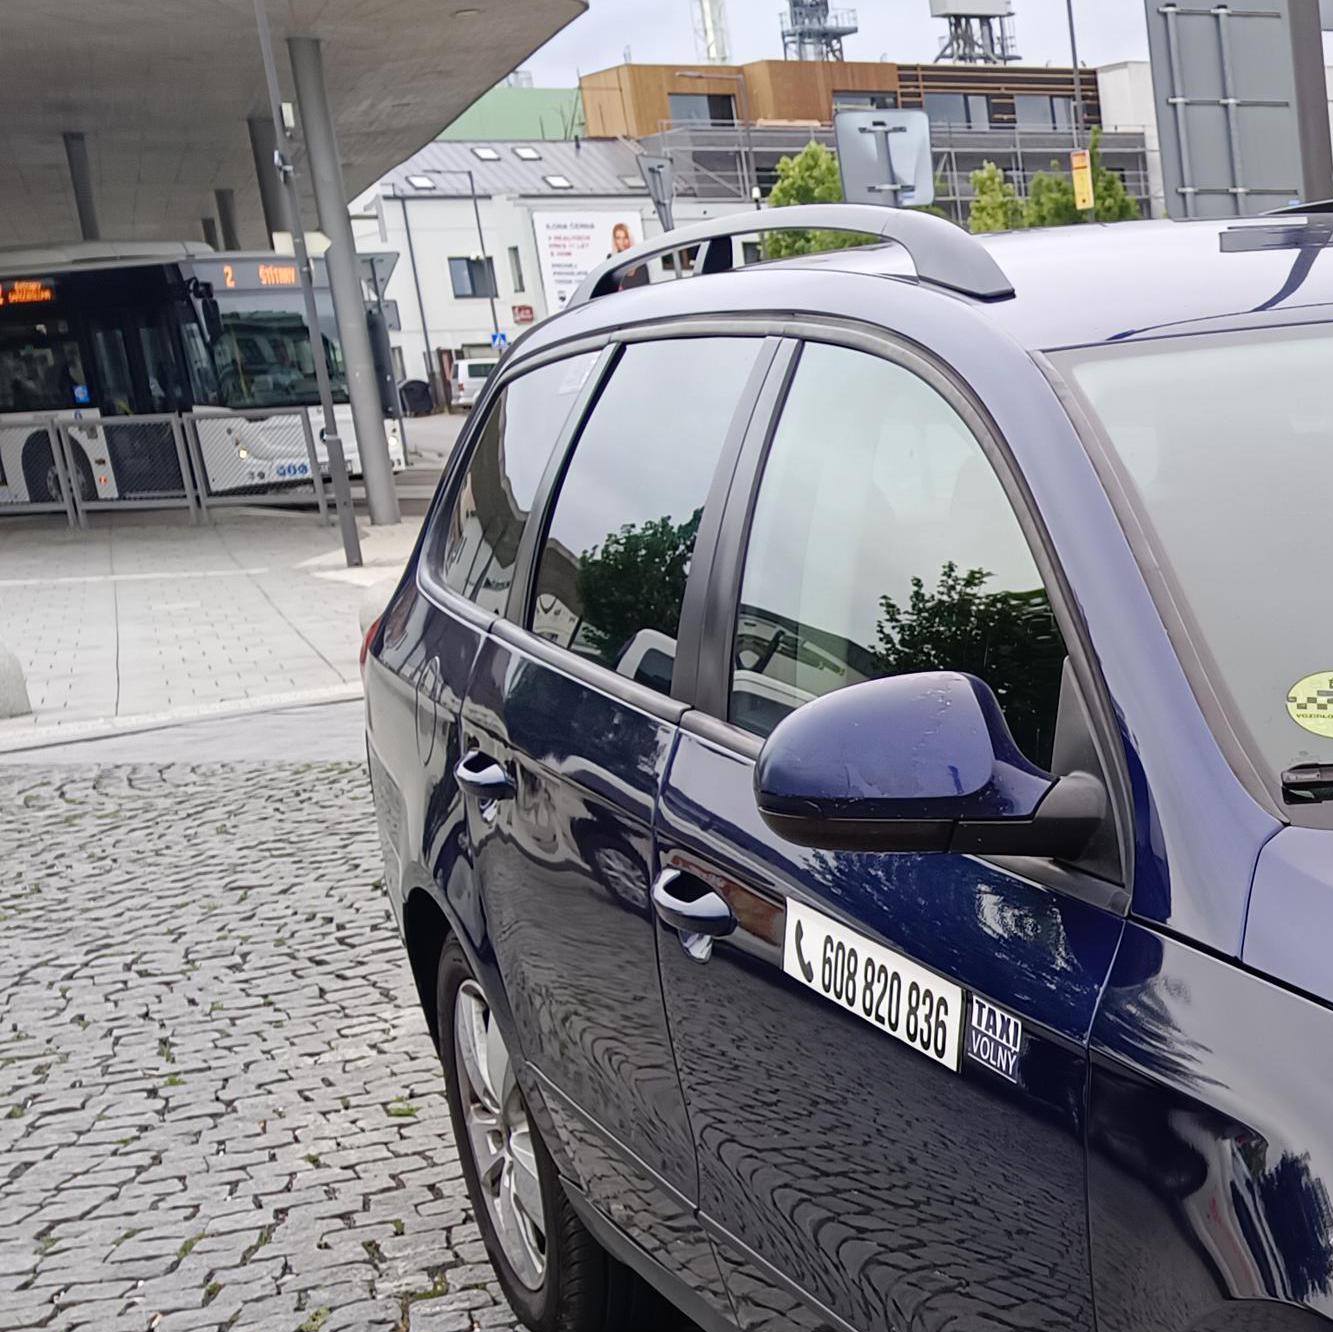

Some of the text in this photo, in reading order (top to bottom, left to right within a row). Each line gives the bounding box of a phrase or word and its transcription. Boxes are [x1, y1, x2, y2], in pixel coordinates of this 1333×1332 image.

[223, 264, 236, 288] 2
[821, 934, 949, 1059] 608 820 836
[975, 998, 1019, 1050] TAXI
[972, 1029, 1017, 1075] VOLNÝ
